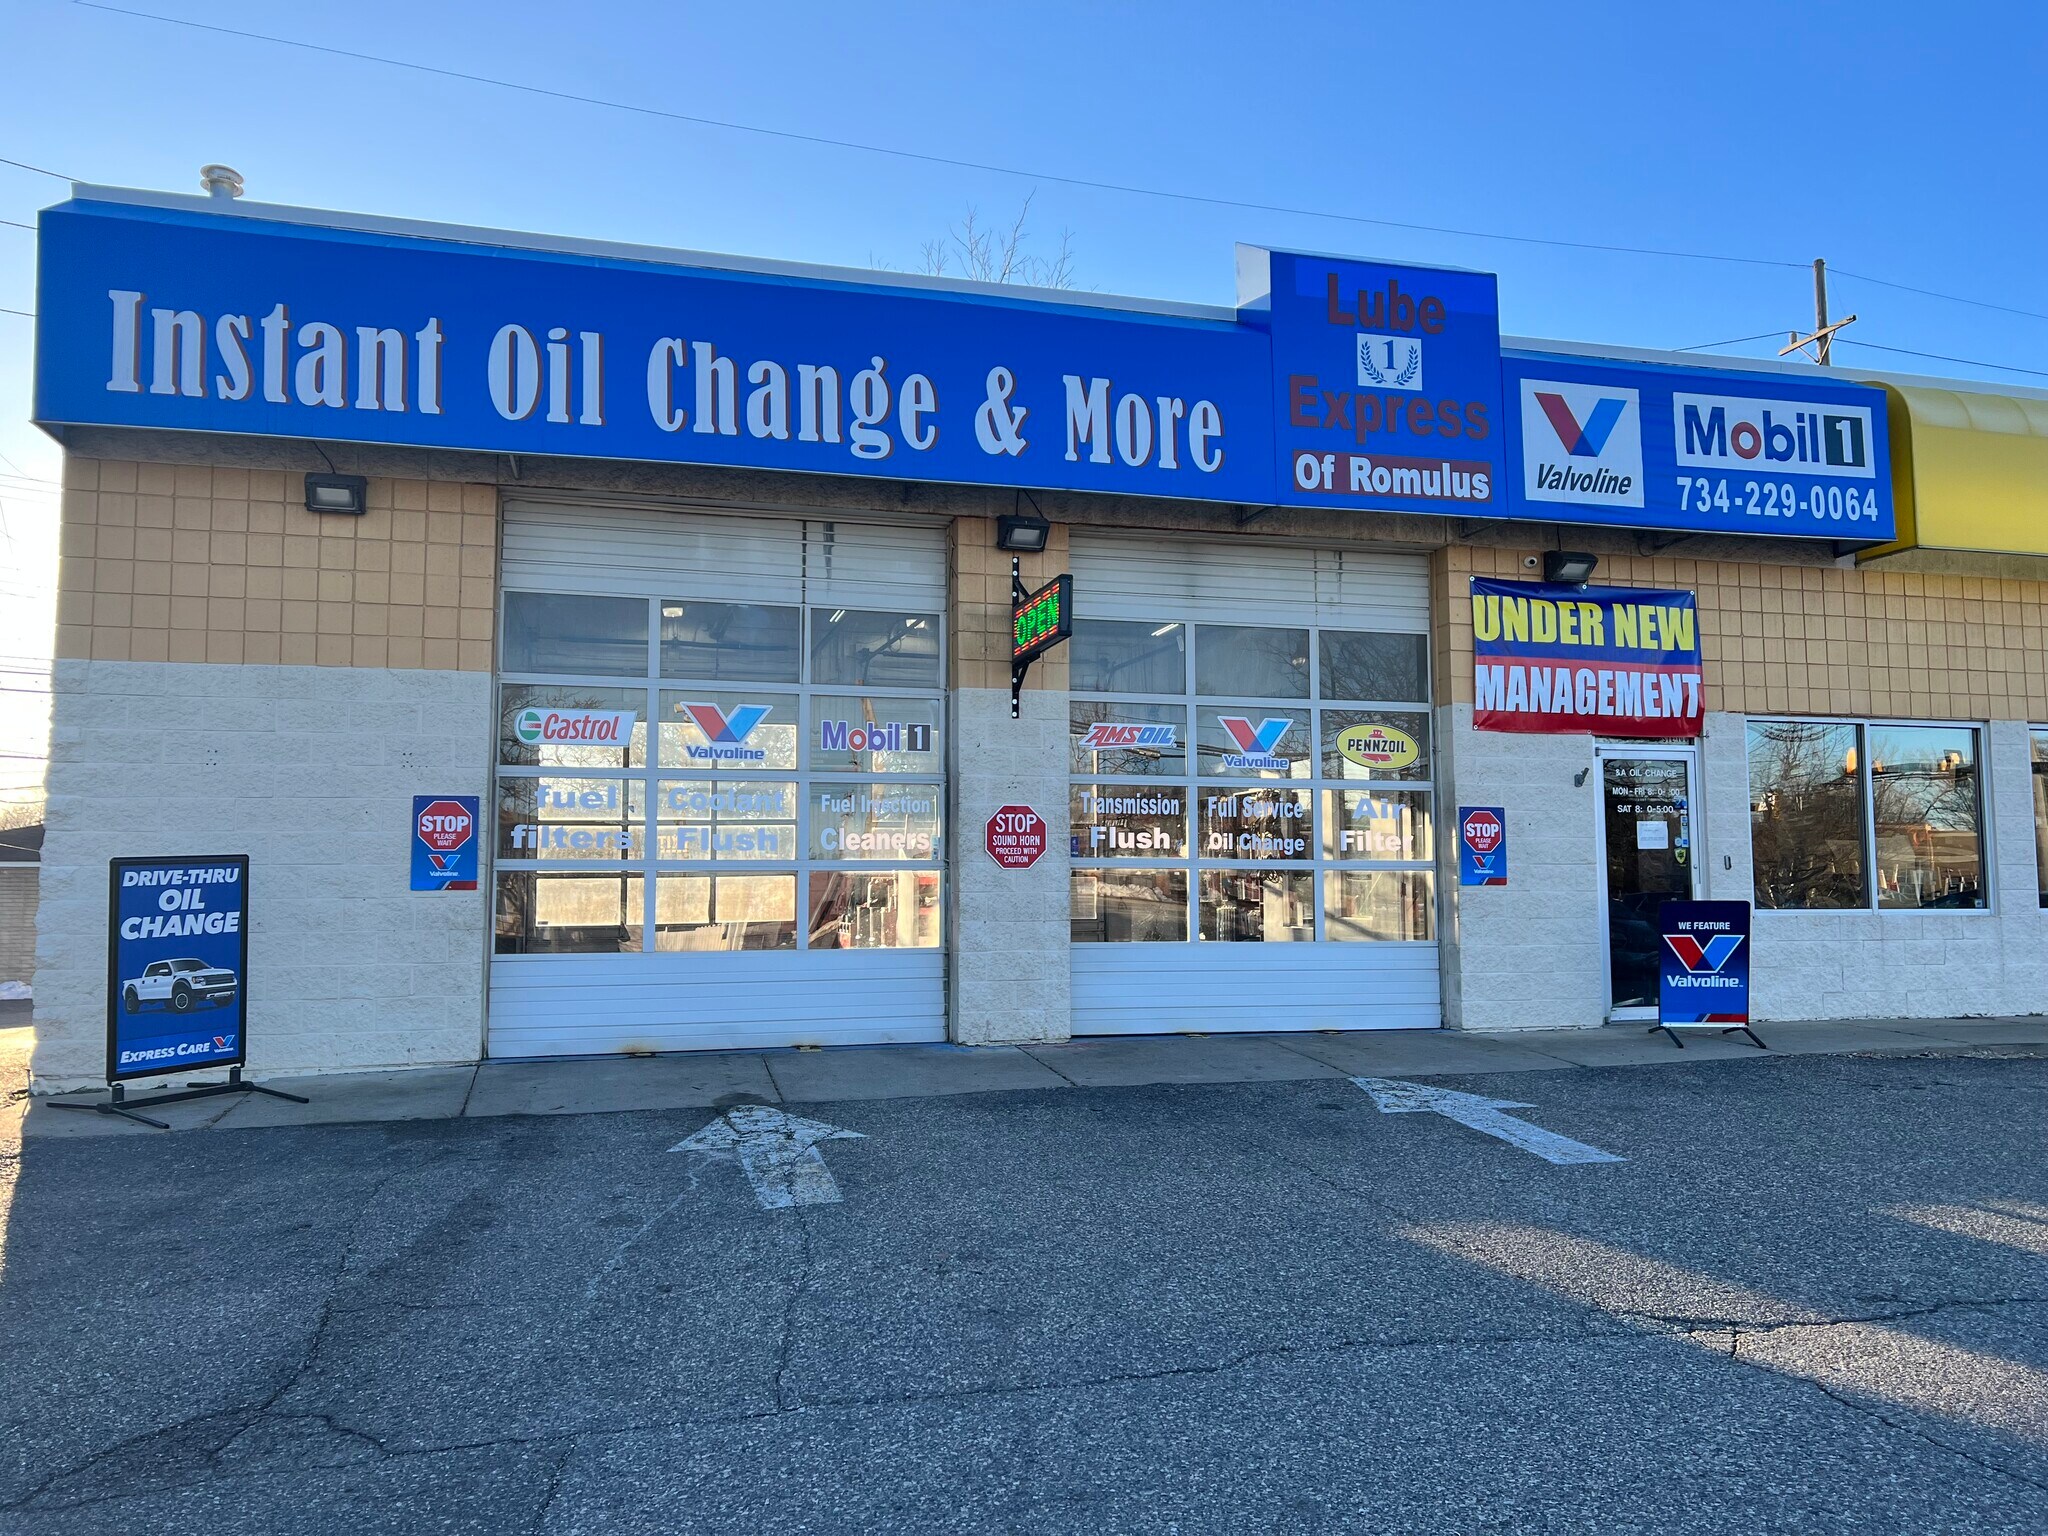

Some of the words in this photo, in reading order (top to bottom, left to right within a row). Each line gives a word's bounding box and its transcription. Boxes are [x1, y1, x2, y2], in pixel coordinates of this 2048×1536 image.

[1328, 273, 1446, 334] Lube
[106, 289, 444, 414] Instant
[487, 323, 605, 426] Oil
[647, 336, 939, 460] Change
[974, 366, 1028, 457] &
[1062, 375, 1224, 473] More
[1289, 374, 1490, 445] Express
[1683, 404, 1820, 463] Mobil
[1295, 453, 1335, 490] Of
[1350, 456, 1490, 500] Romulus
[1537, 463, 1632, 496] Valvoline
[1677, 476, 1878, 521] 734-229-0064
[1017, 593, 1059, 645] OPEN
[1472, 594, 1604, 647] UNDER
[1612, 603, 1695, 651] NEW
[1475, 664, 1701, 718] MANAGEMENT
[543, 713, 621, 740] Castrol
[822, 721, 901, 751] Mobil
[1087, 726, 1176, 745] AMSOIL
[686, 746, 765, 759] Valvoline
[1348, 739, 1407, 753] PENNZOIL
[1224, 756, 1289, 768] Valvoline
[1629, 768, 1642, 777] OIL
[1645, 769, 1677, 778] CHANGE
[535, 785, 617, 809] fuel
[668, 787, 785, 812] Coolant
[821, 794, 856, 813] Fuel
[861, 794, 931, 817] Injection
[1080, 791, 1180, 815] Transmission
[1208, 796, 1237, 817] Full
[1242, 796, 1304, 818] Service
[1352, 798, 1406, 819] Air
[1617, 804, 1631, 813] SAT
[421, 815, 469, 832] STOP
[995, 813, 1037, 833] STOP
[1466, 823, 1499, 837] STOP
[511, 824, 633, 850] filters
[677, 828, 778, 851] Flush
[821, 827, 931, 851] Cleaners
[992, 835, 1017, 846] SOUND
[1020, 835, 1040, 846] HORN
[1090, 827, 1171, 849] Flush
[1208, 832, 1233, 850] Oil
[1240, 833, 1305, 855] Change
[1340, 830, 1414, 852] Filter
[122, 868, 239, 887] DRIVE-THRU
[158, 888, 205, 912] OIL
[120, 911, 240, 940] CHANGE
[1678, 922, 1691, 930] WE
[1694, 922, 1731, 930] FEATURE
[1667, 975, 1739, 987] Valvoline
[120, 1047, 175, 1063] EXPRESS
[177, 1042, 210, 1056] CARE
